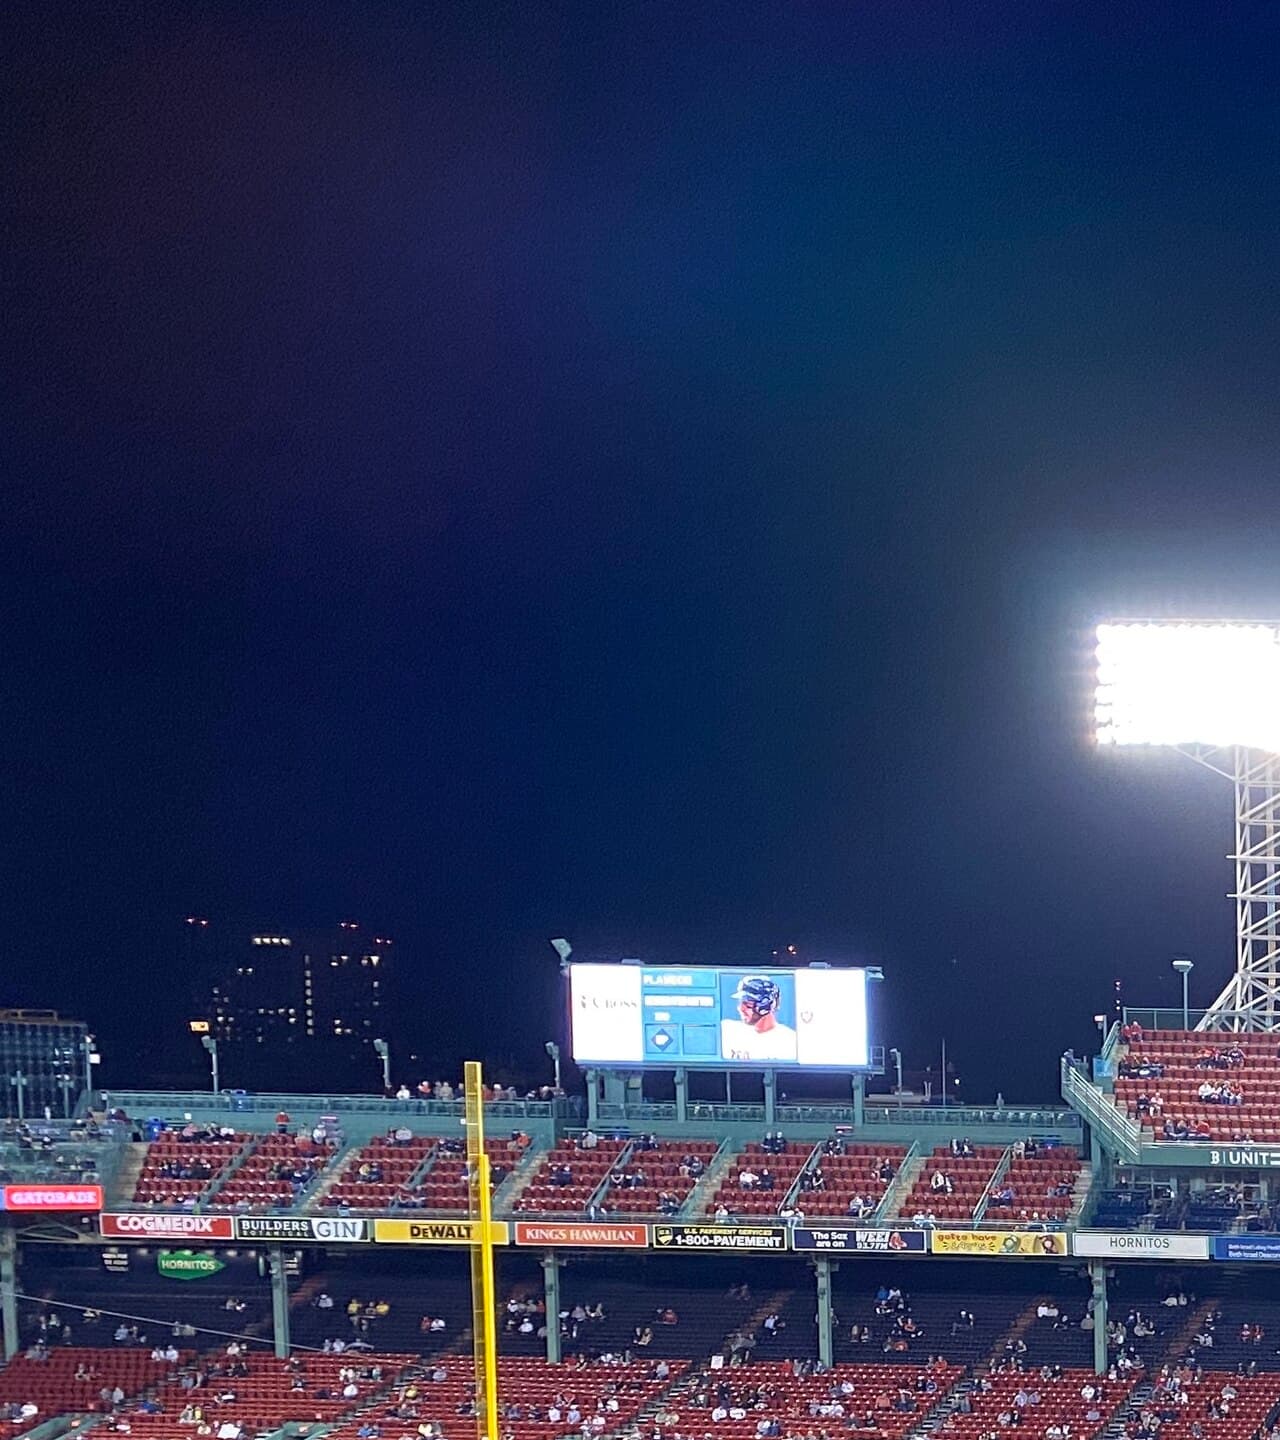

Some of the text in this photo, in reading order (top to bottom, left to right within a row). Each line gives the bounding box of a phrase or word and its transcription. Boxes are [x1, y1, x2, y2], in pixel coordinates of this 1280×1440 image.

[11, 1191, 97, 1205] GATORADE
[116, 1215, 213, 1233] COGMEDIX
[241, 1219, 309, 1231] BUILDERS
[317, 1221, 358, 1239] GIN
[569, 1229, 636, 1243] HAWAIIAN
[675, 1235, 782, 1248] 1-800-PAVEMENT
[811, 1231, 829, 1240] The
[856, 1231, 890, 1243] WEEI
[971, 1234, 997, 1242] have
[832, 1240, 845, 1248] on
[1109, 1237, 1170, 1249] HORNITOS
[161, 1259, 215, 1271] HORNITOS
